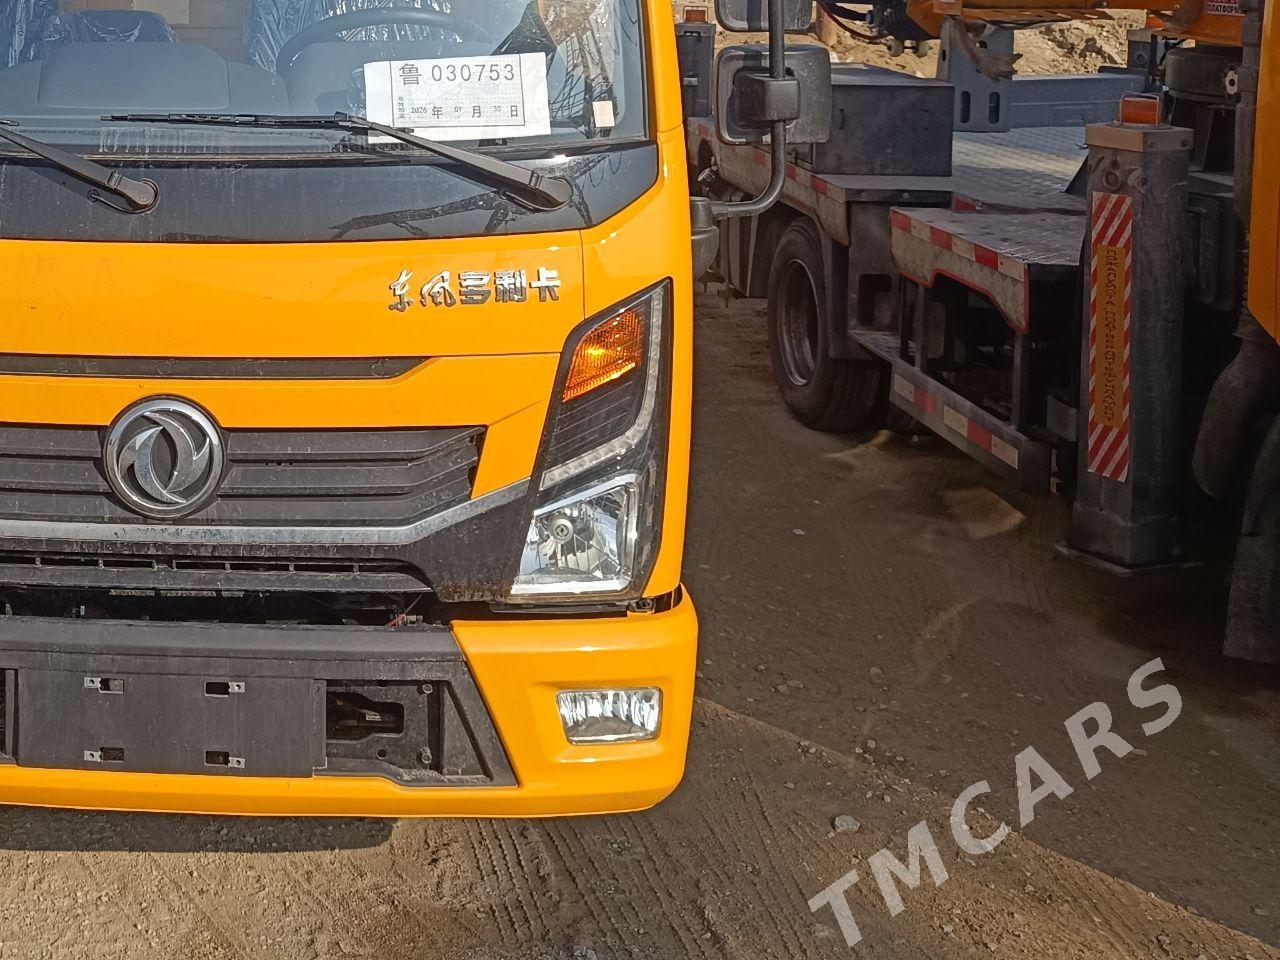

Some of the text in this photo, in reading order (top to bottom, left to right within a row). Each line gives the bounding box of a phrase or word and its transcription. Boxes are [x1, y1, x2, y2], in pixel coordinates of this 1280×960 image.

[398, 62, 515, 86] 鲁 030753
[431, 105, 443, 119] 年
[471, 105, 482, 119] 月
[510, 105, 519, 118] 日
[388, 266, 562, 312] 东风多利卡
